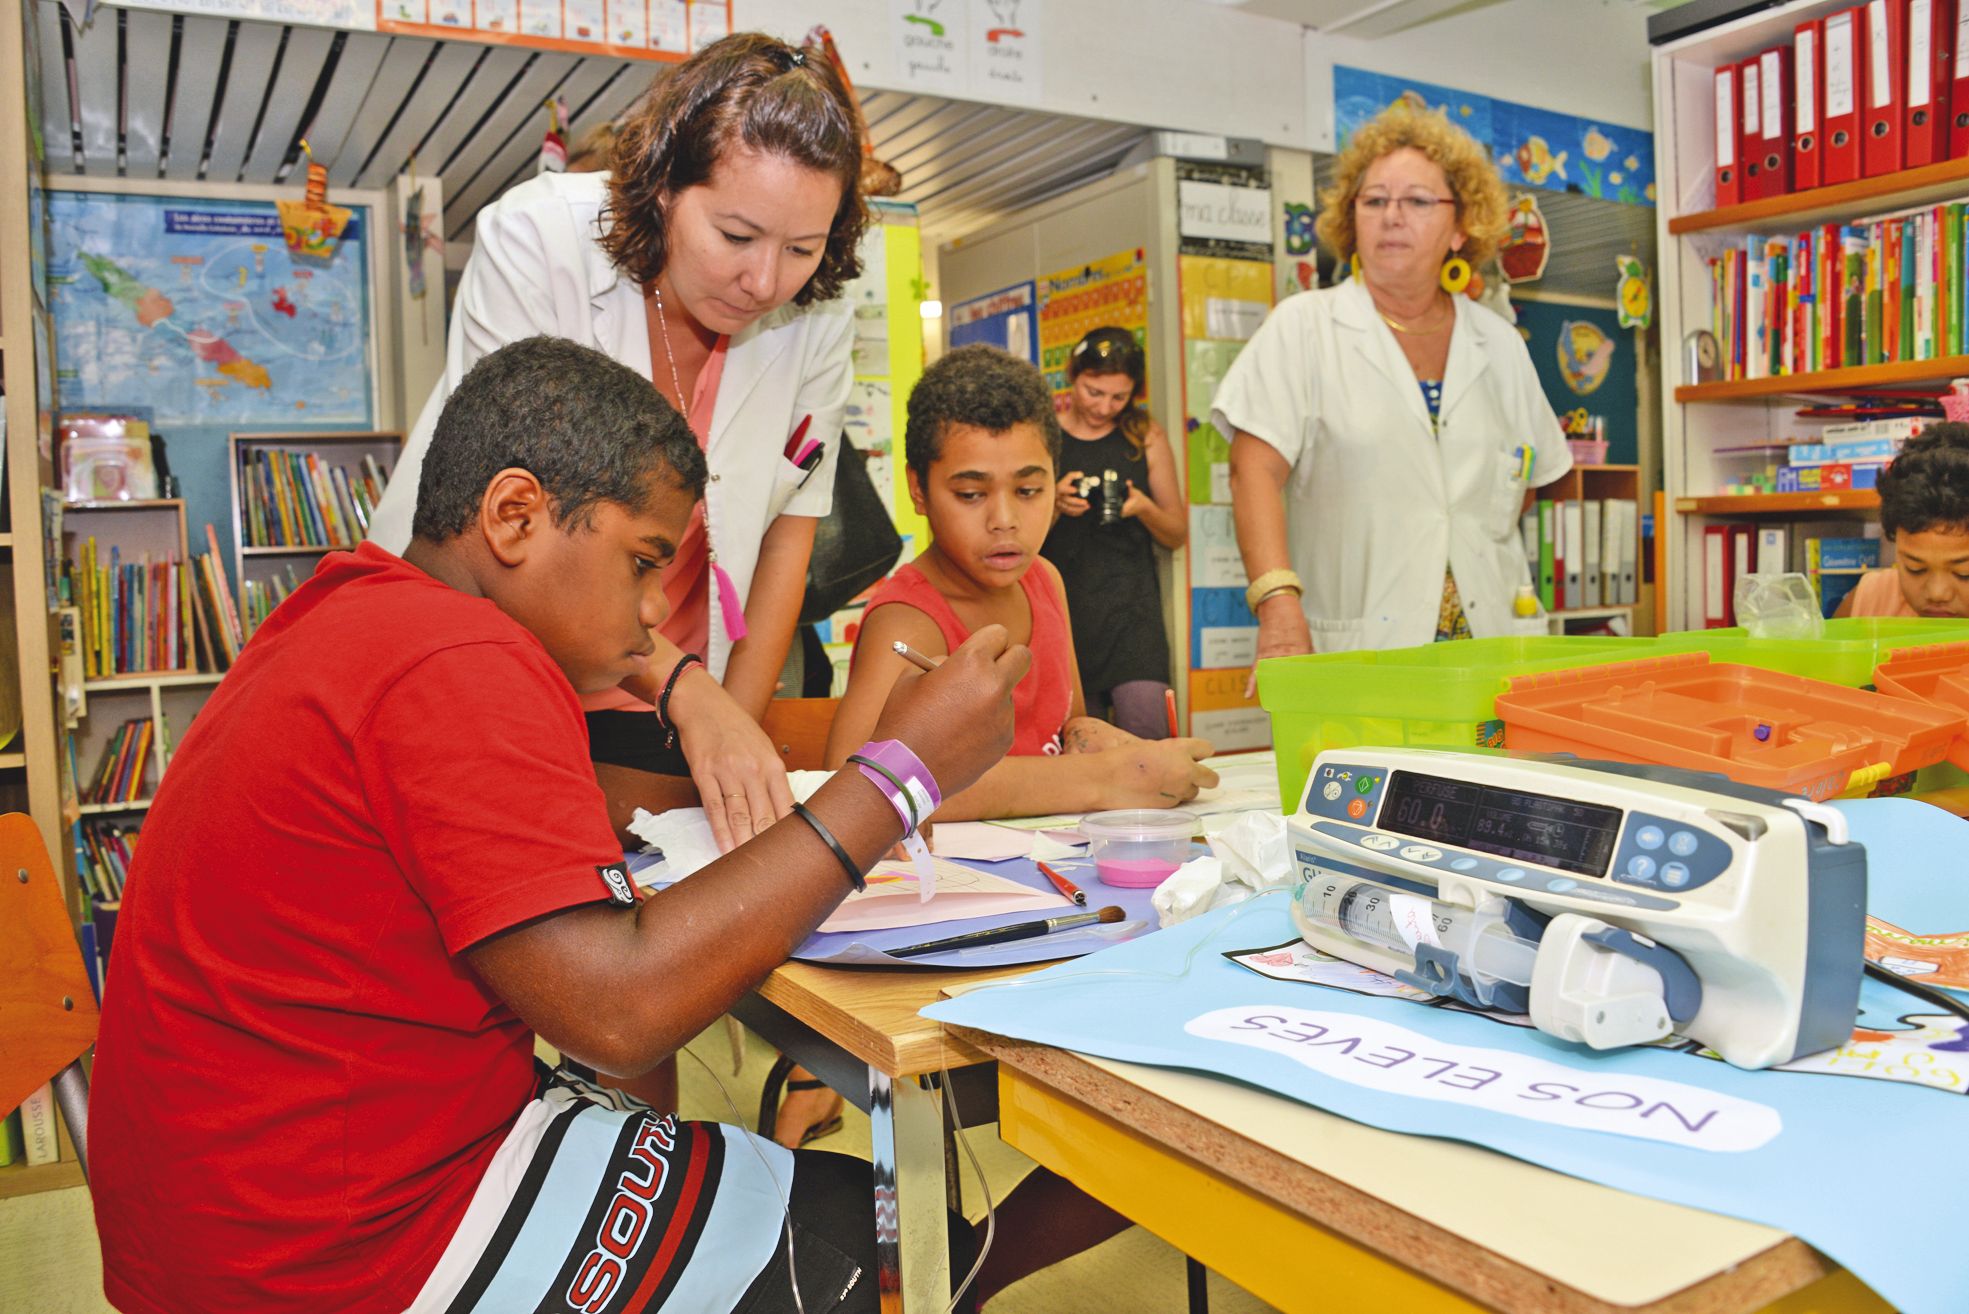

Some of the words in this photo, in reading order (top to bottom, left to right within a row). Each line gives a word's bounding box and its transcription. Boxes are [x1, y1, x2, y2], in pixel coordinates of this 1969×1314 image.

[1397, 796, 1445, 830] 60.0
[1323, 885, 1337, 898] 10
[1365, 897, 1380, 912] 30
[1437, 917, 1453, 933] 60
[1230, 1015, 1502, 1090] ELEVES
[1517, 1082, 1719, 1132] NOS
[31, 1098, 48, 1159] LAROUSSE
[847, 1266, 862, 1290] SOUTH
